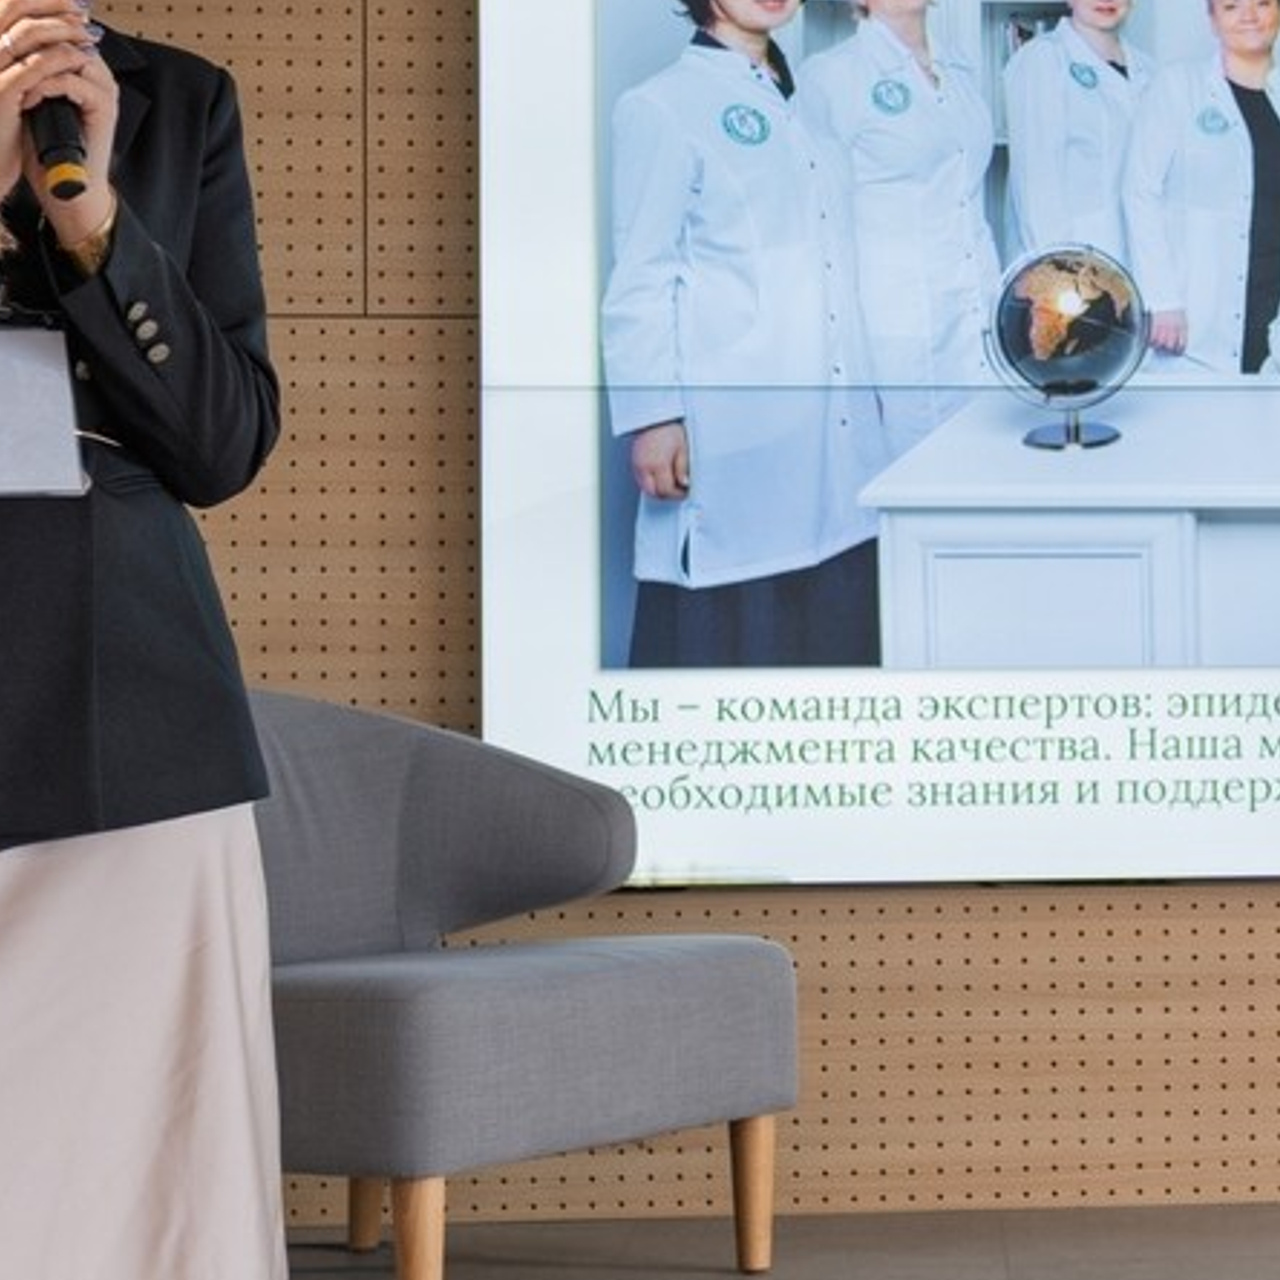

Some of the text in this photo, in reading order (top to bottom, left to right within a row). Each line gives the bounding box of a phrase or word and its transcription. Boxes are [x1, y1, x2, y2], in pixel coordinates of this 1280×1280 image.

[588, 689, 660, 723] Мы
[715, 695, 904, 729] команда
[917, 693, 1153, 730] экспертов:
[588, 738, 896, 771] менеджмента
[911, 735, 1112, 764] качества.
[1128, 726, 1244, 761] Наша
[620, 773, 894, 815] еобходимые
[907, 780, 1061, 808] знания
[1075, 780, 1100, 804] и
